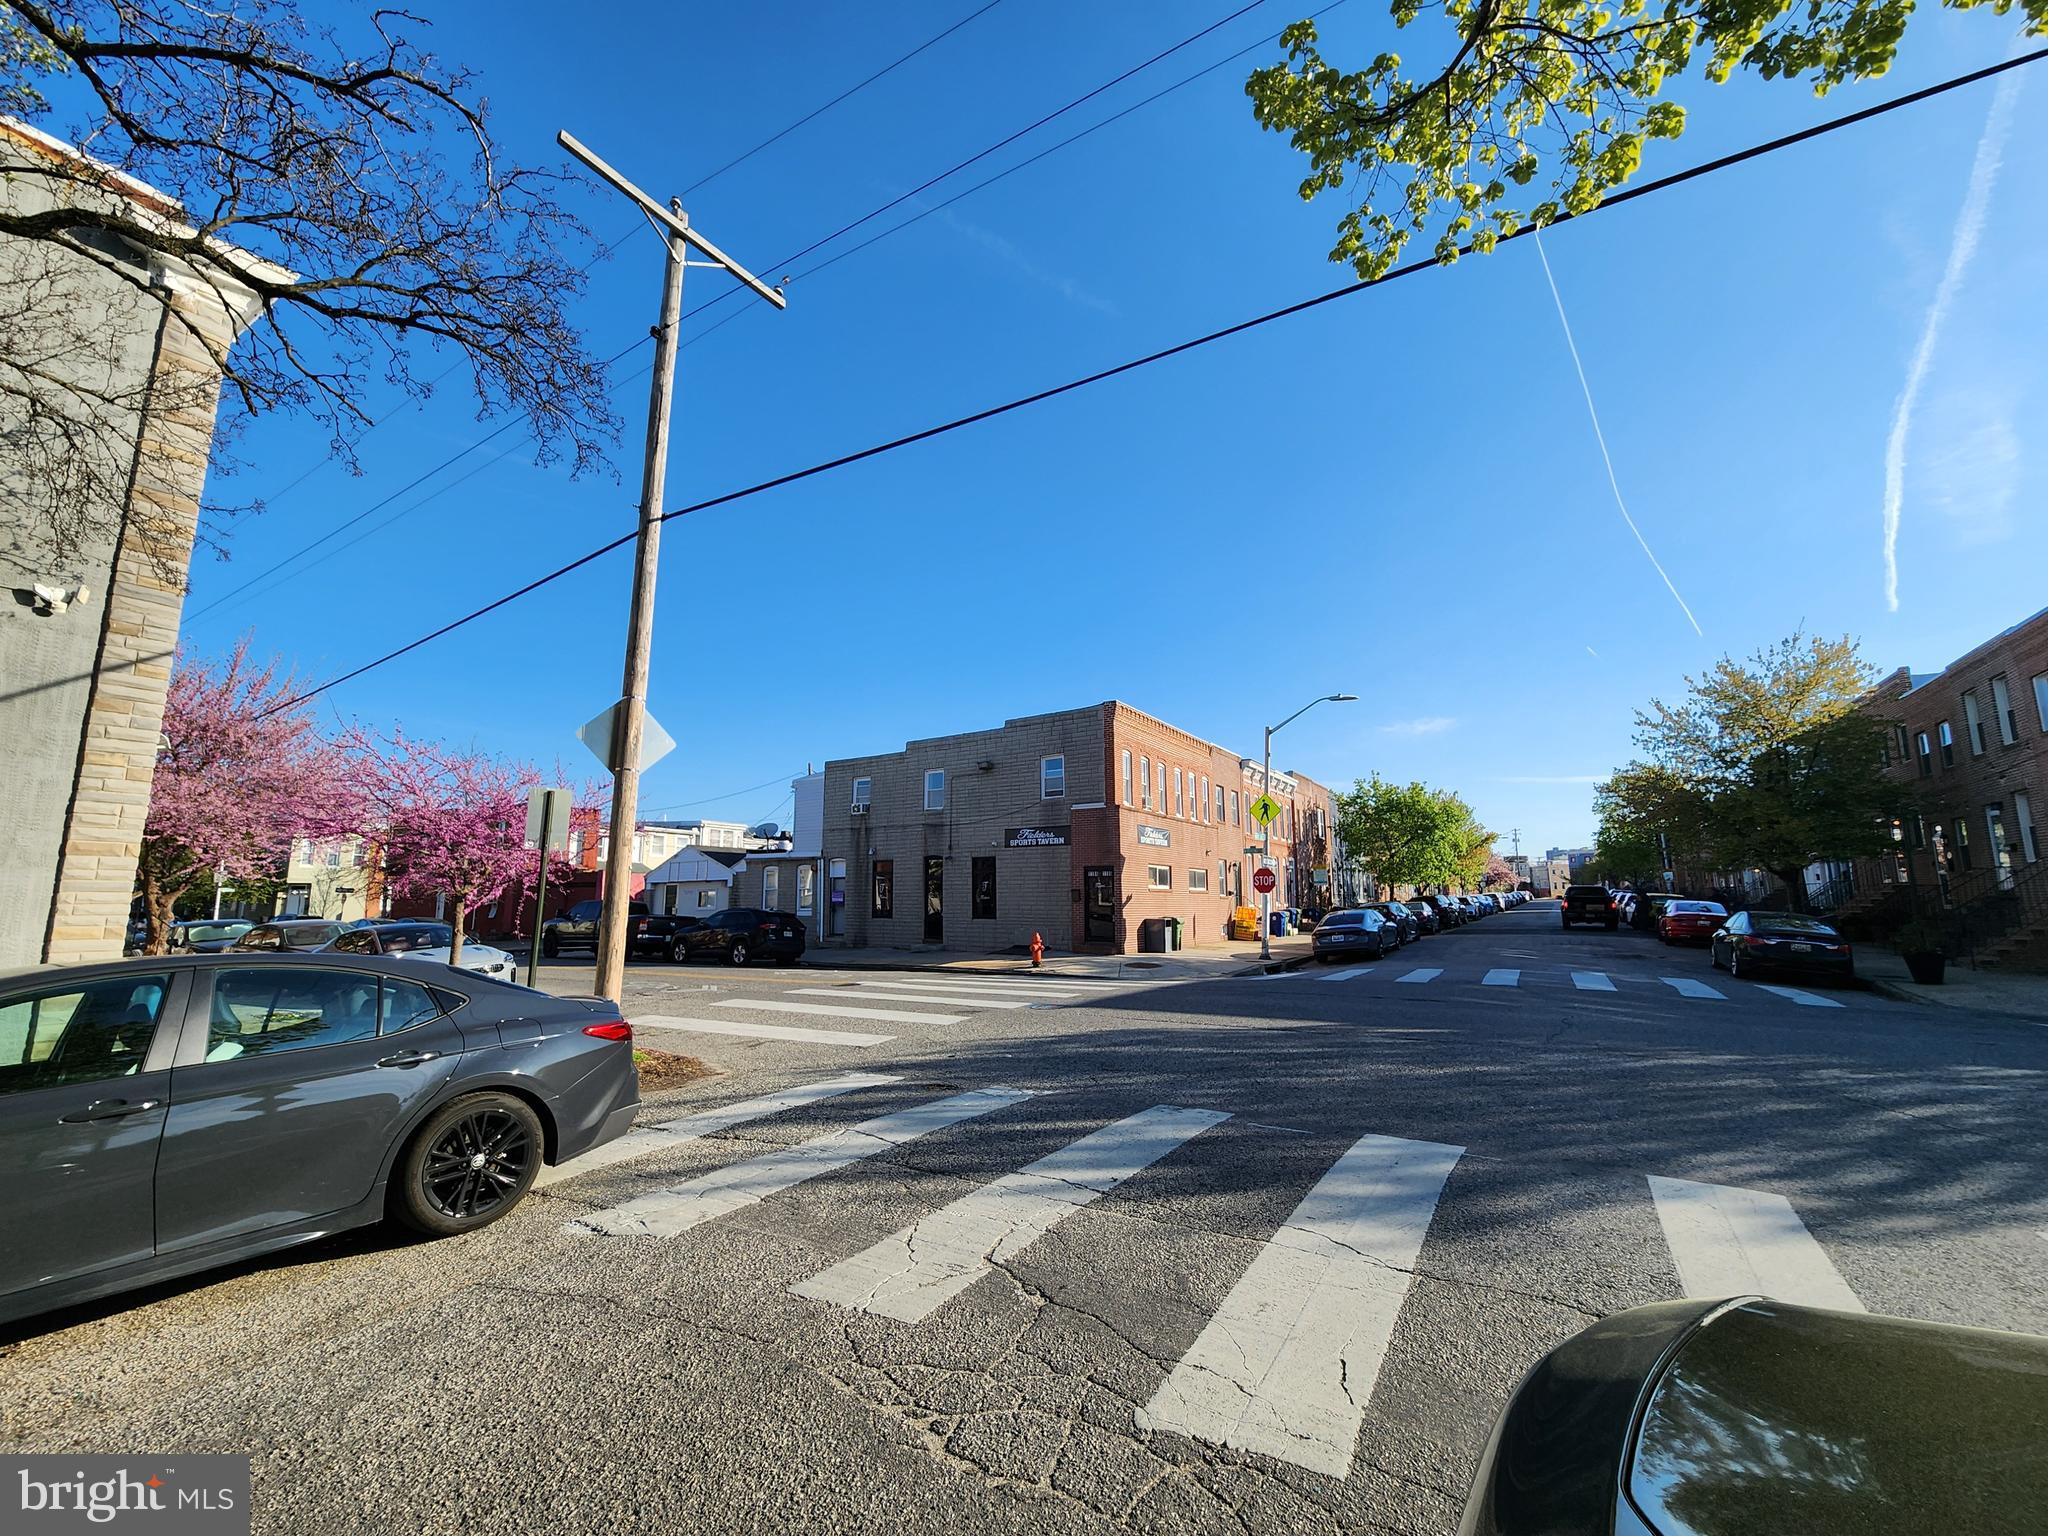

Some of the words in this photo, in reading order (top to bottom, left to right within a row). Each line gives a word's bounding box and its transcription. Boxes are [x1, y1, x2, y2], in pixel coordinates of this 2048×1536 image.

[1010, 839, 1037, 847] SPORTS
[1037, 837, 1065, 845] TAVERN
[1254, 875, 1275, 886] STOP
